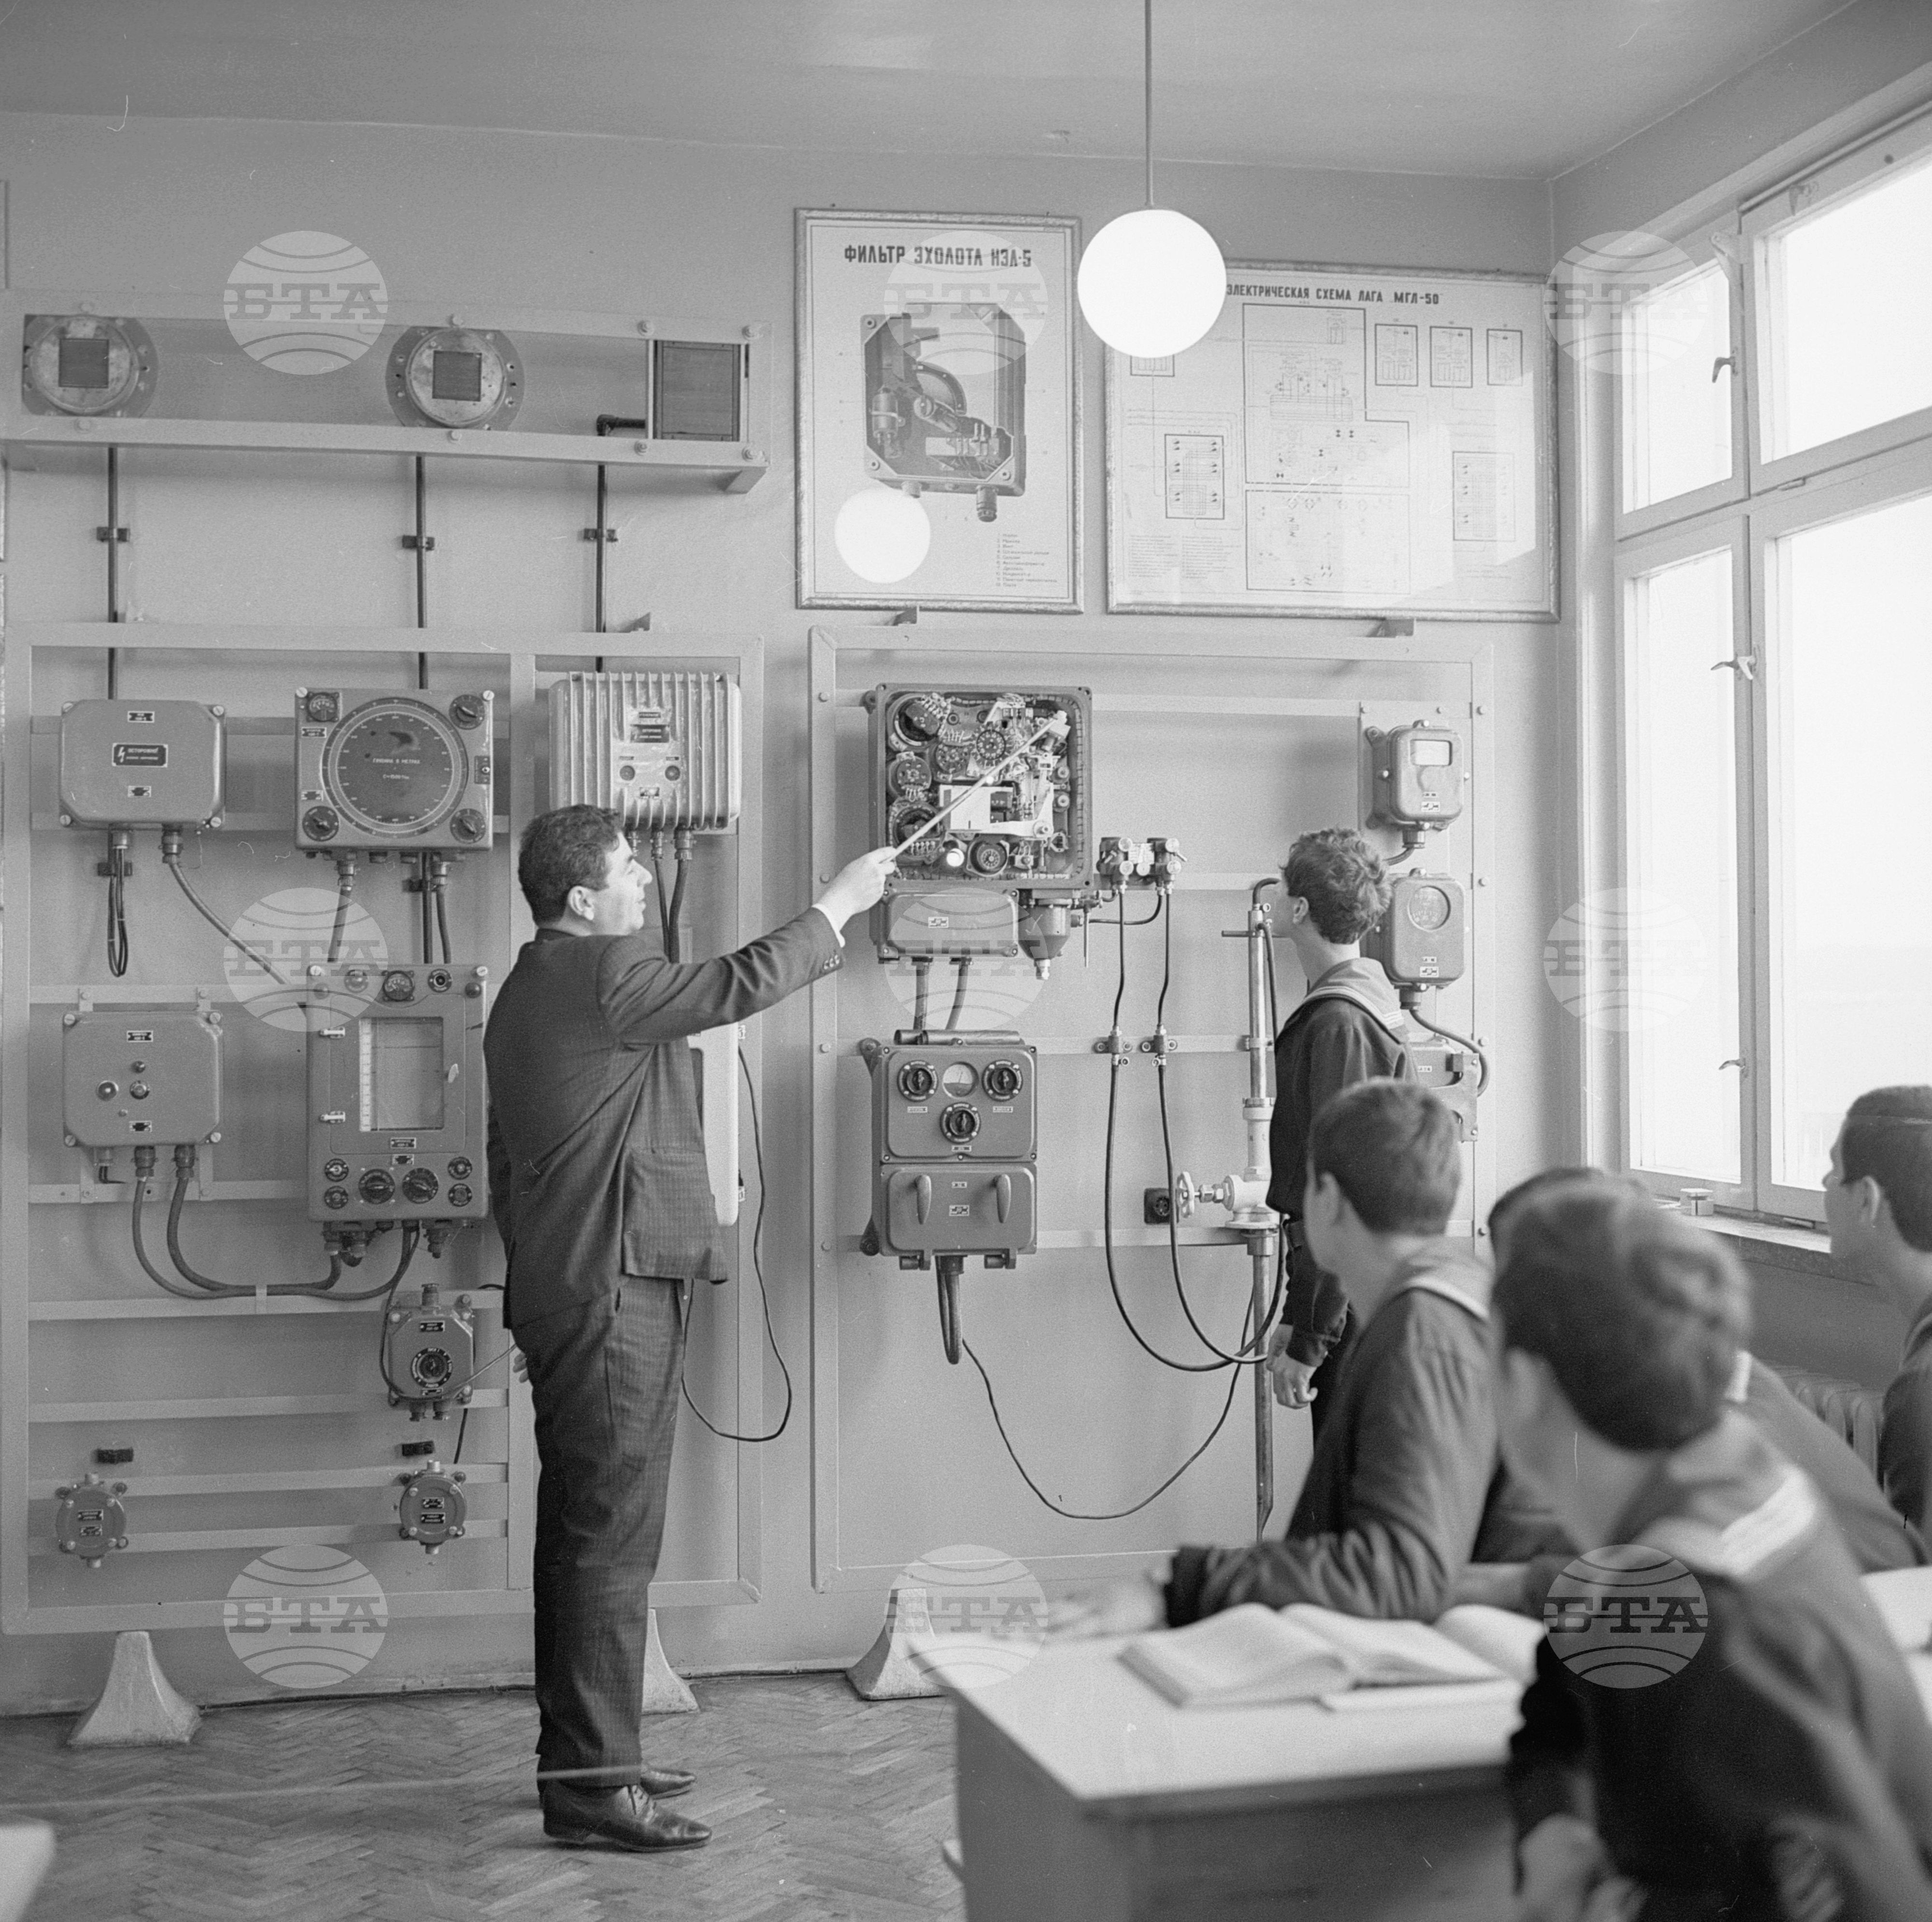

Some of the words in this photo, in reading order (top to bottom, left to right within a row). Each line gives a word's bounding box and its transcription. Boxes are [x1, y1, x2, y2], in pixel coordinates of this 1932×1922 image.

[844, 245, 905, 263] ФИЛЬТР
[914, 246, 982, 266] ЭХОЛОТА
[1227, 284, 1309, 299] ЭЛЕКТРИЧЕСКАЯ
[1316, 288, 1351, 300] СХЕМА
[1358, 291, 1383, 302] ЛАГА
[1394, 292, 1439, 305] МГЛ-50
